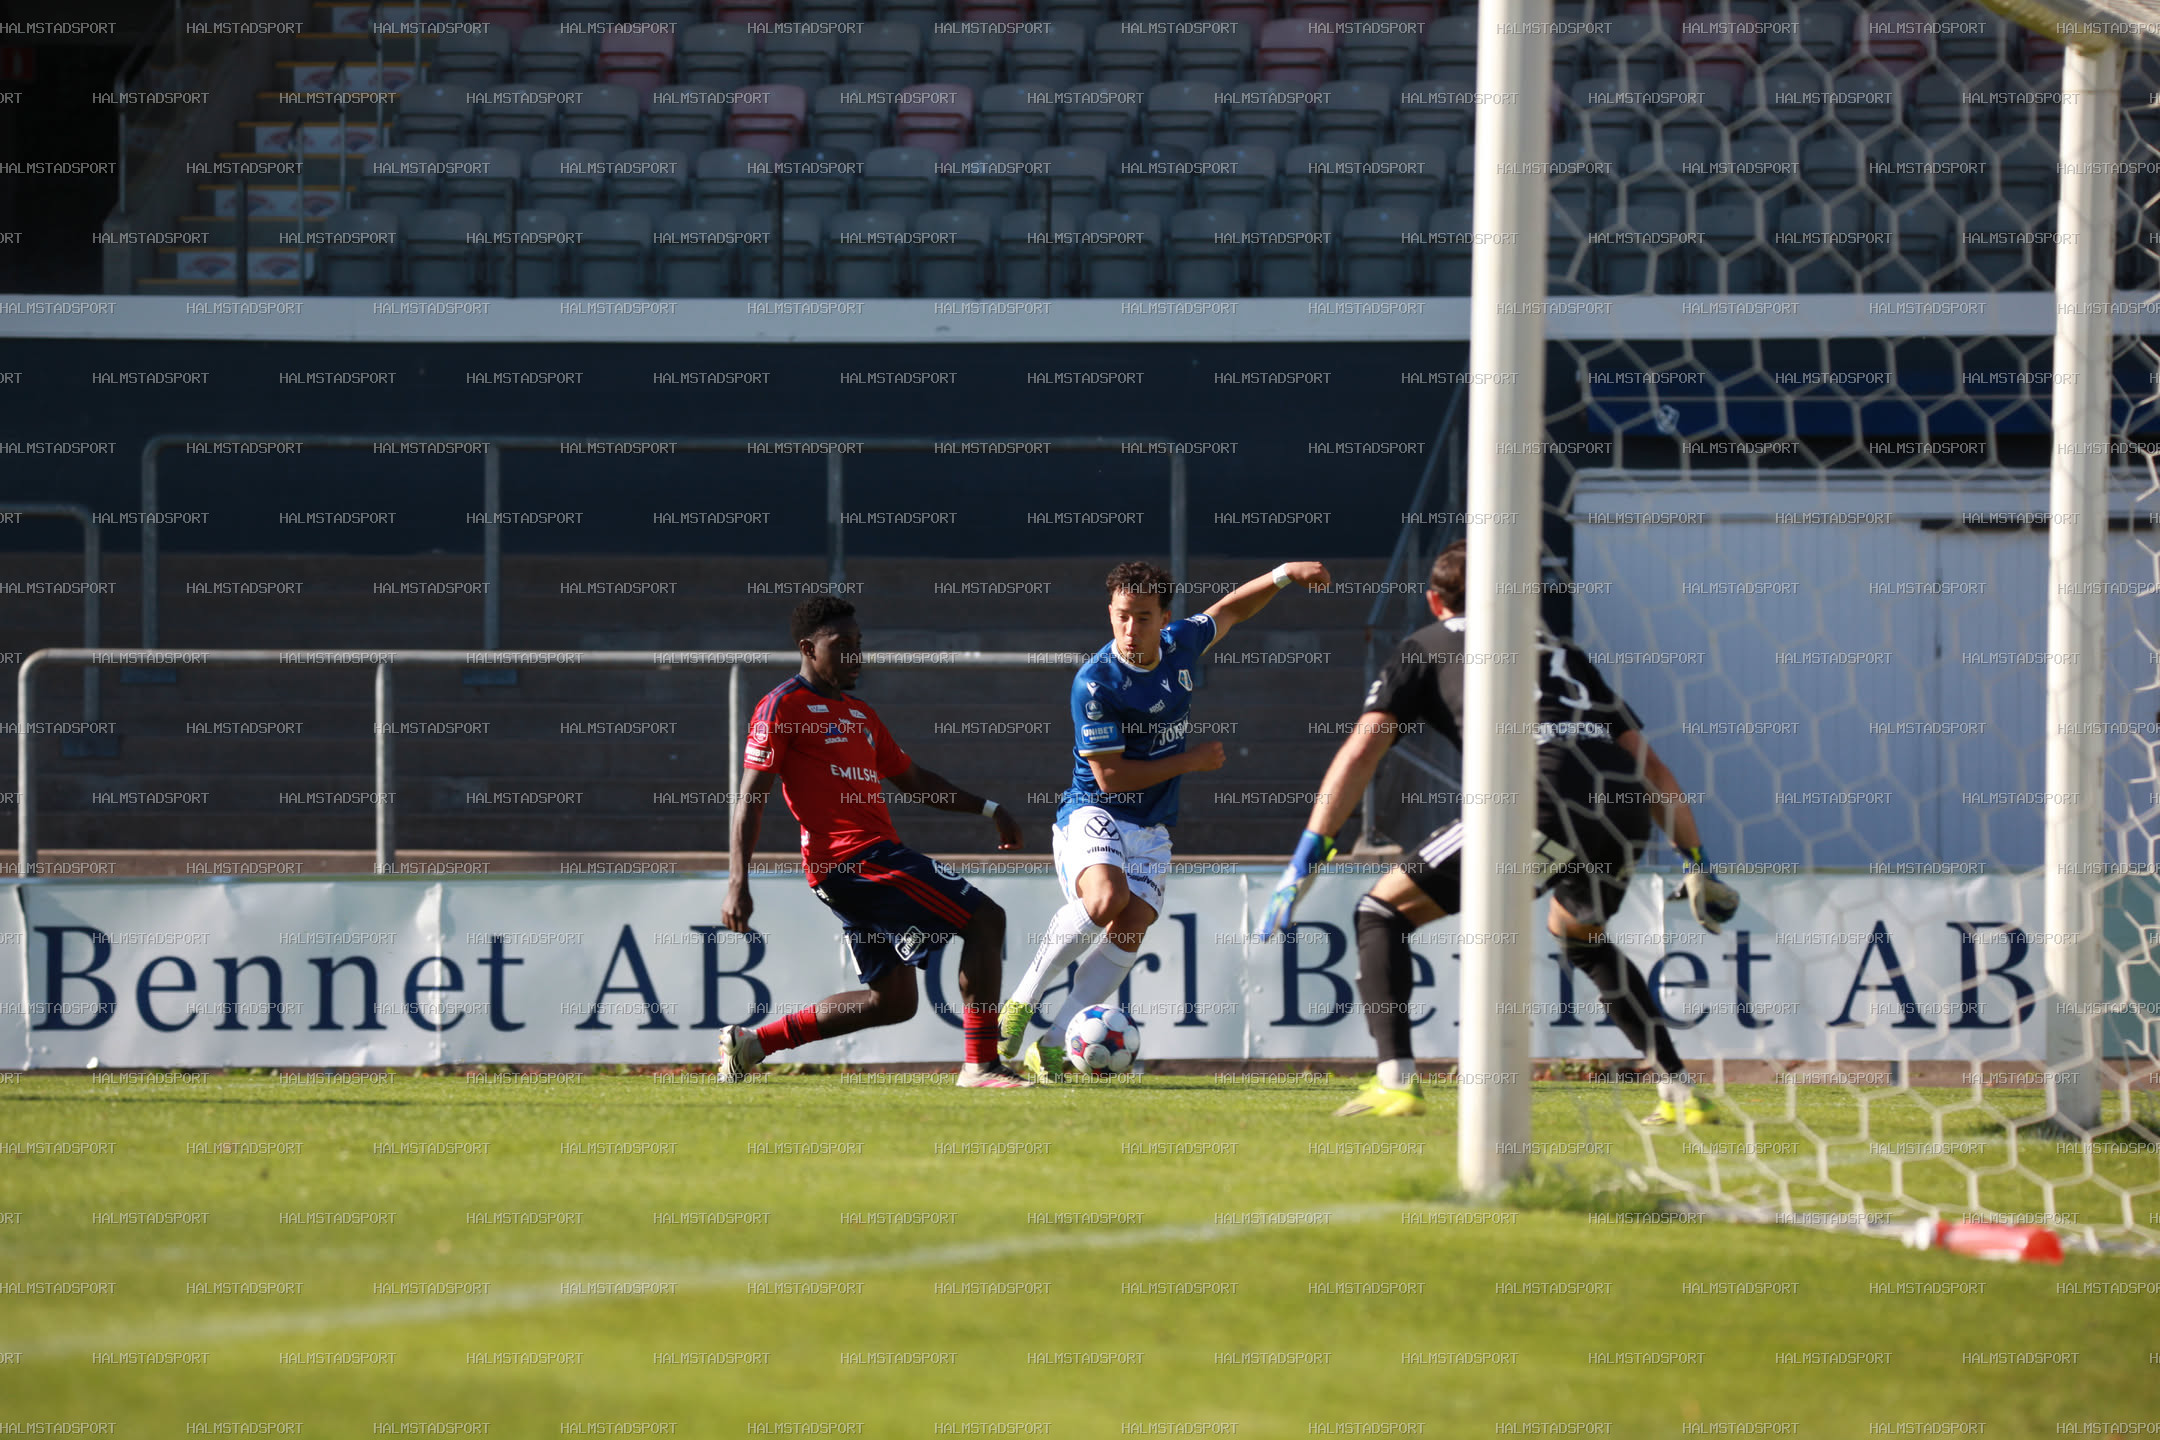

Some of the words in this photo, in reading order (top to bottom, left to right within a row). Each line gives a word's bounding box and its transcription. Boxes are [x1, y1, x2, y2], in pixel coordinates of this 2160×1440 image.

[1083, 726, 1114, 737] UNIBET
[830, 764, 880, 784] EMILSH
[33, 926, 526, 1032] Bennet
[575, 924, 773, 1030] AB
[1825, 920, 2036, 1029] AB
